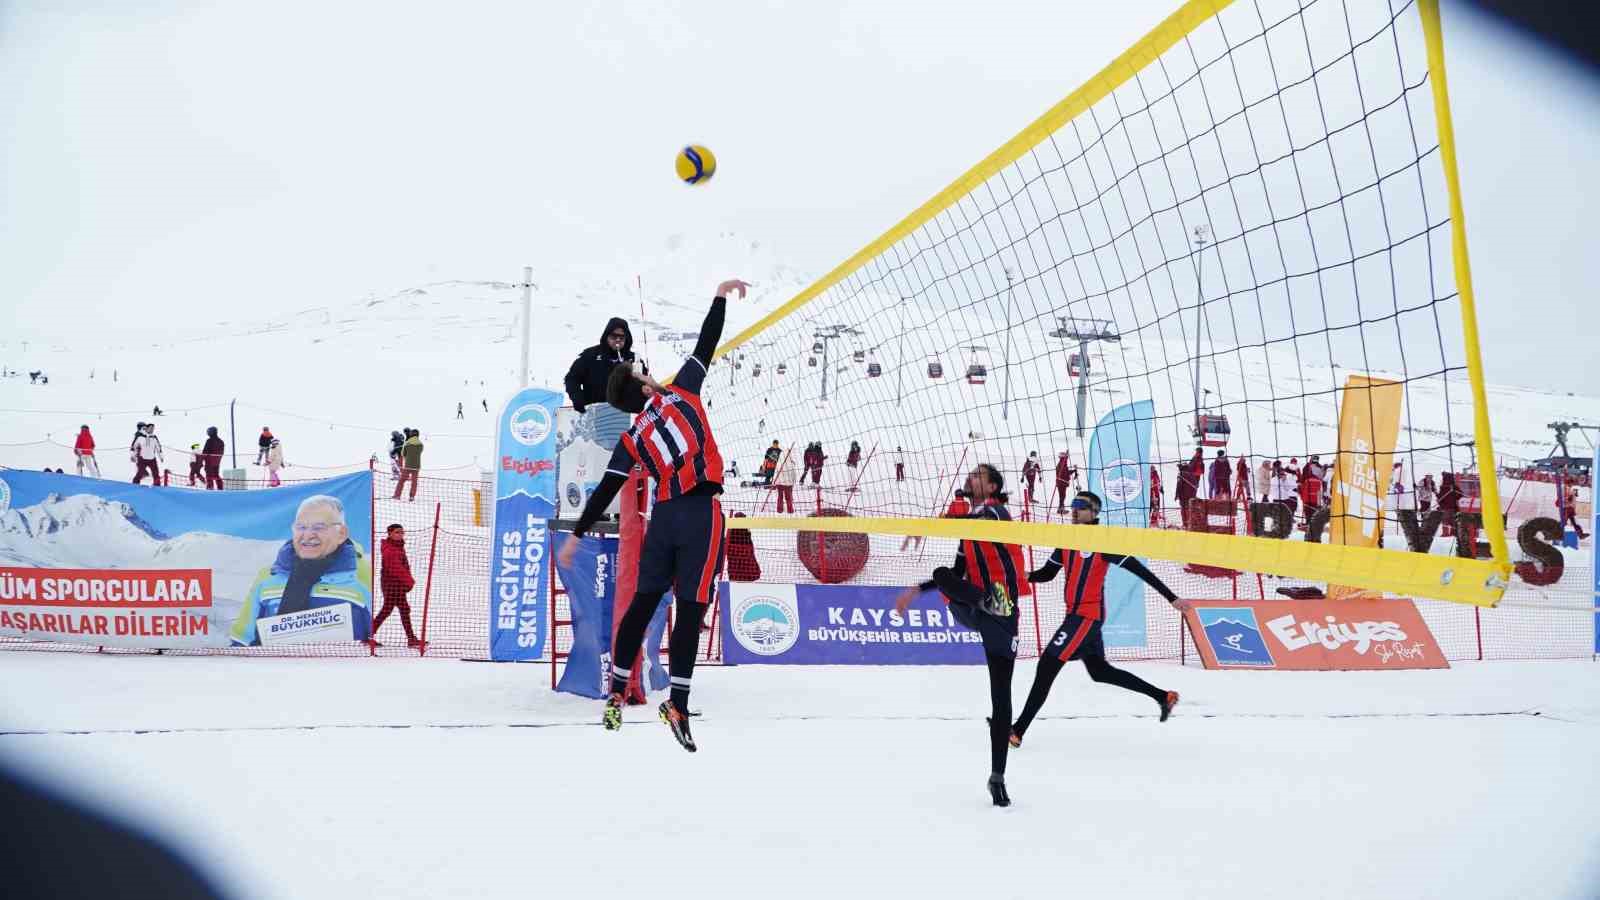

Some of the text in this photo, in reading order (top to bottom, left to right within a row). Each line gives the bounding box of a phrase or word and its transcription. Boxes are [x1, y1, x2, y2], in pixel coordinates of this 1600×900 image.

[0, 572, 203, 602] ÜM SPORCULARA
[496, 531, 521, 629] ERCİYES
[517, 513, 546, 648] SKI RESORT
[114, 610, 209, 636] DİLERİM
[808, 627, 900, 645] BÜYÜKŞEHİR
[1265, 614, 1408, 655] Erciyes
[1053, 631, 1068, 646] 3
